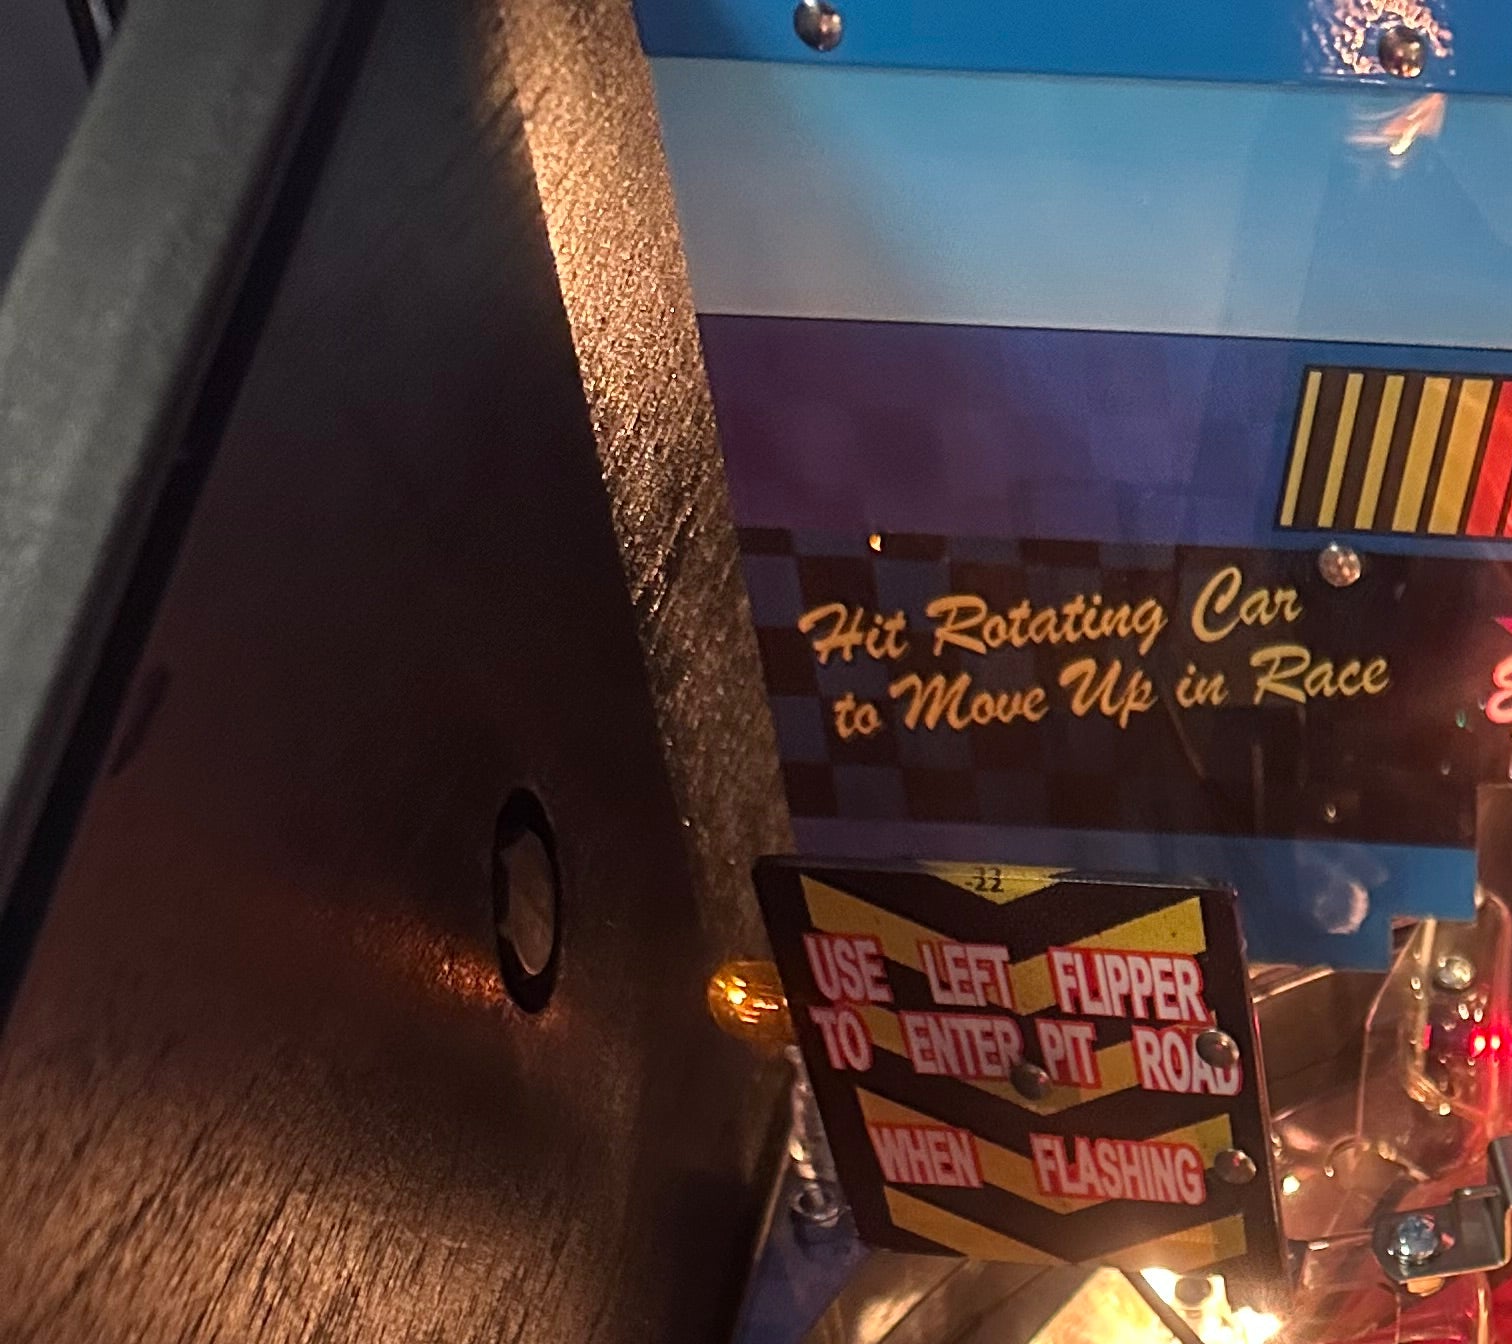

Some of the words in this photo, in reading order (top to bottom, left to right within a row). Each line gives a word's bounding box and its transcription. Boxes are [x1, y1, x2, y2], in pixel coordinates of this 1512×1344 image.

[799, 602, 907, 664] Hit
[925, 595, 1168, 656] Rotating
[1191, 567, 1302, 642] Car
[835, 697, 881, 741] to
[889, 672, 1048, 732] Move
[1058, 658, 1158, 729] Up
[1175, 665, 1228, 707] in
[1249, 645, 1390, 703] Race
[804, 933, 893, 1001] USE
[918, 941, 1014, 1008] LEFT
[1048, 946, 1212, 1023] FLIPPER
[809, 1004, 874, 1071] TO
[902, 1011, 1024, 1080] ENTER
[1036, 1019, 1101, 1088] PIT
[1132, 1025, 1242, 1096] ROAD
[871, 1124, 984, 1187] WHEN
[1030, 1133, 1205, 1204] FLASHING
